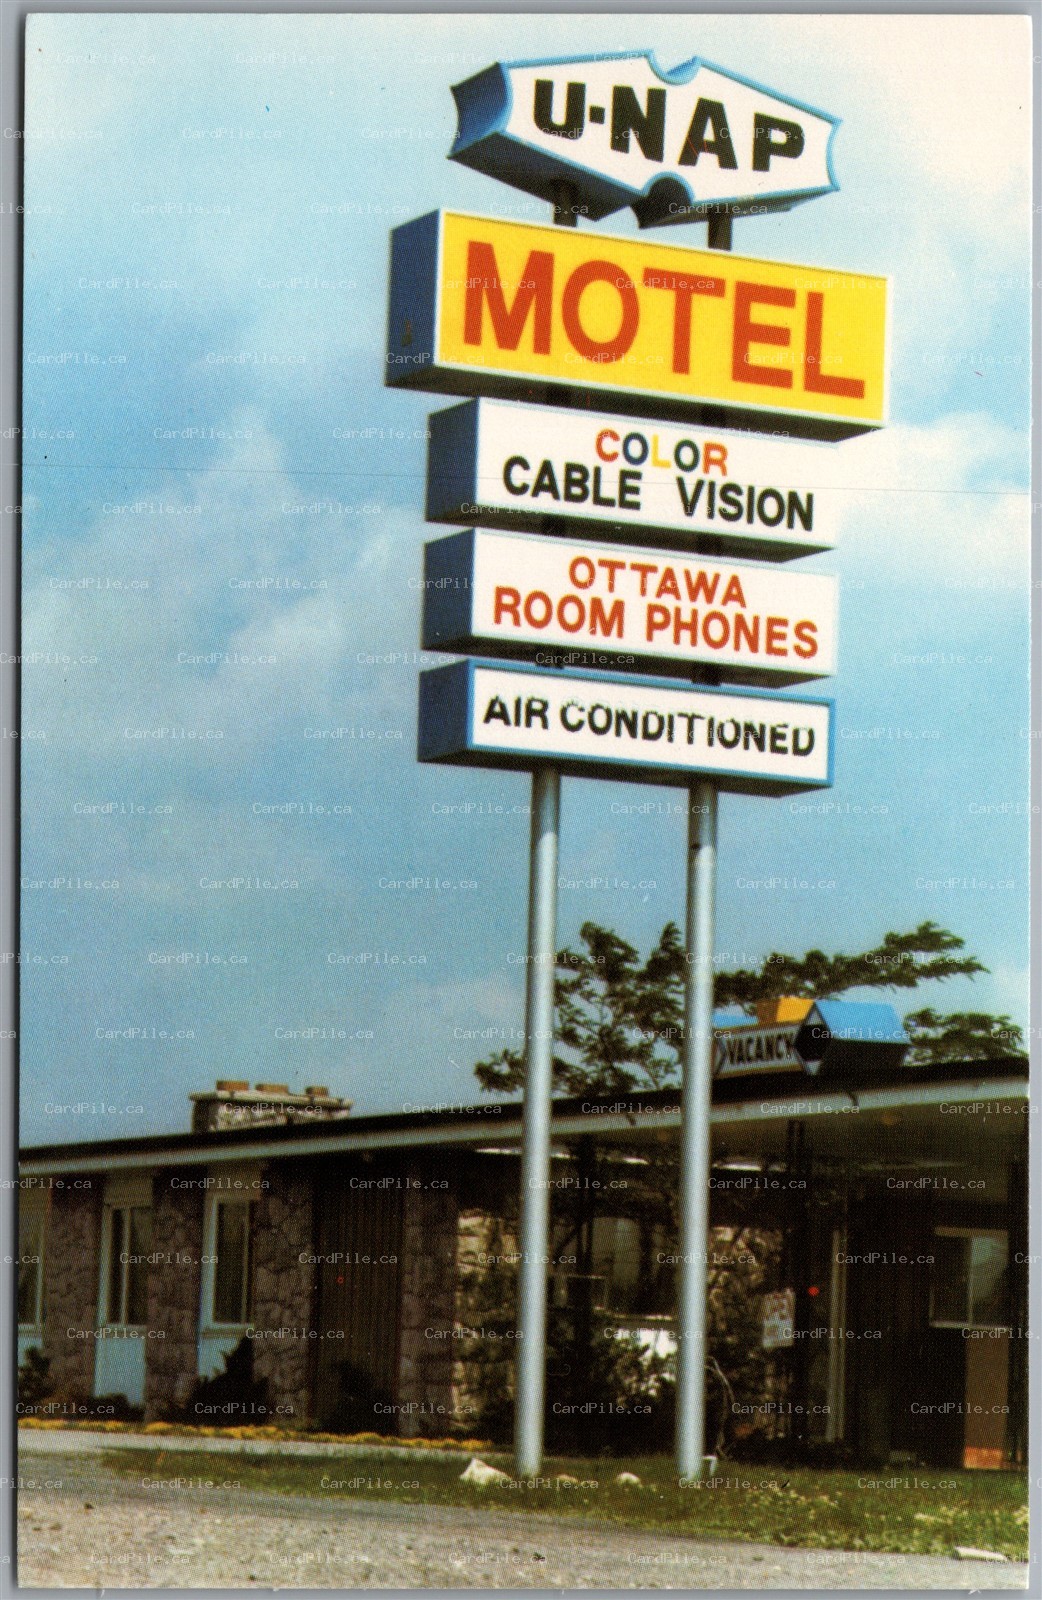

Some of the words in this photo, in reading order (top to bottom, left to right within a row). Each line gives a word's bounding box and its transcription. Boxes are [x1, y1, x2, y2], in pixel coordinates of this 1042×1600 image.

[534, 79, 805, 171] U-NAP
[463, 240, 865, 399] MOTEL
[595, 428, 728, 477] COLOR
[503, 455, 643, 511] CABLE
[676, 475, 814, 532] VISION
[569, 555, 747, 609] OTTAWA
[494, 585, 625, 639] ROOM
[646, 603, 819, 660] PHONES
[483, 695, 549, 729] AIR
[559, 699, 816, 757] CONDITIONED
